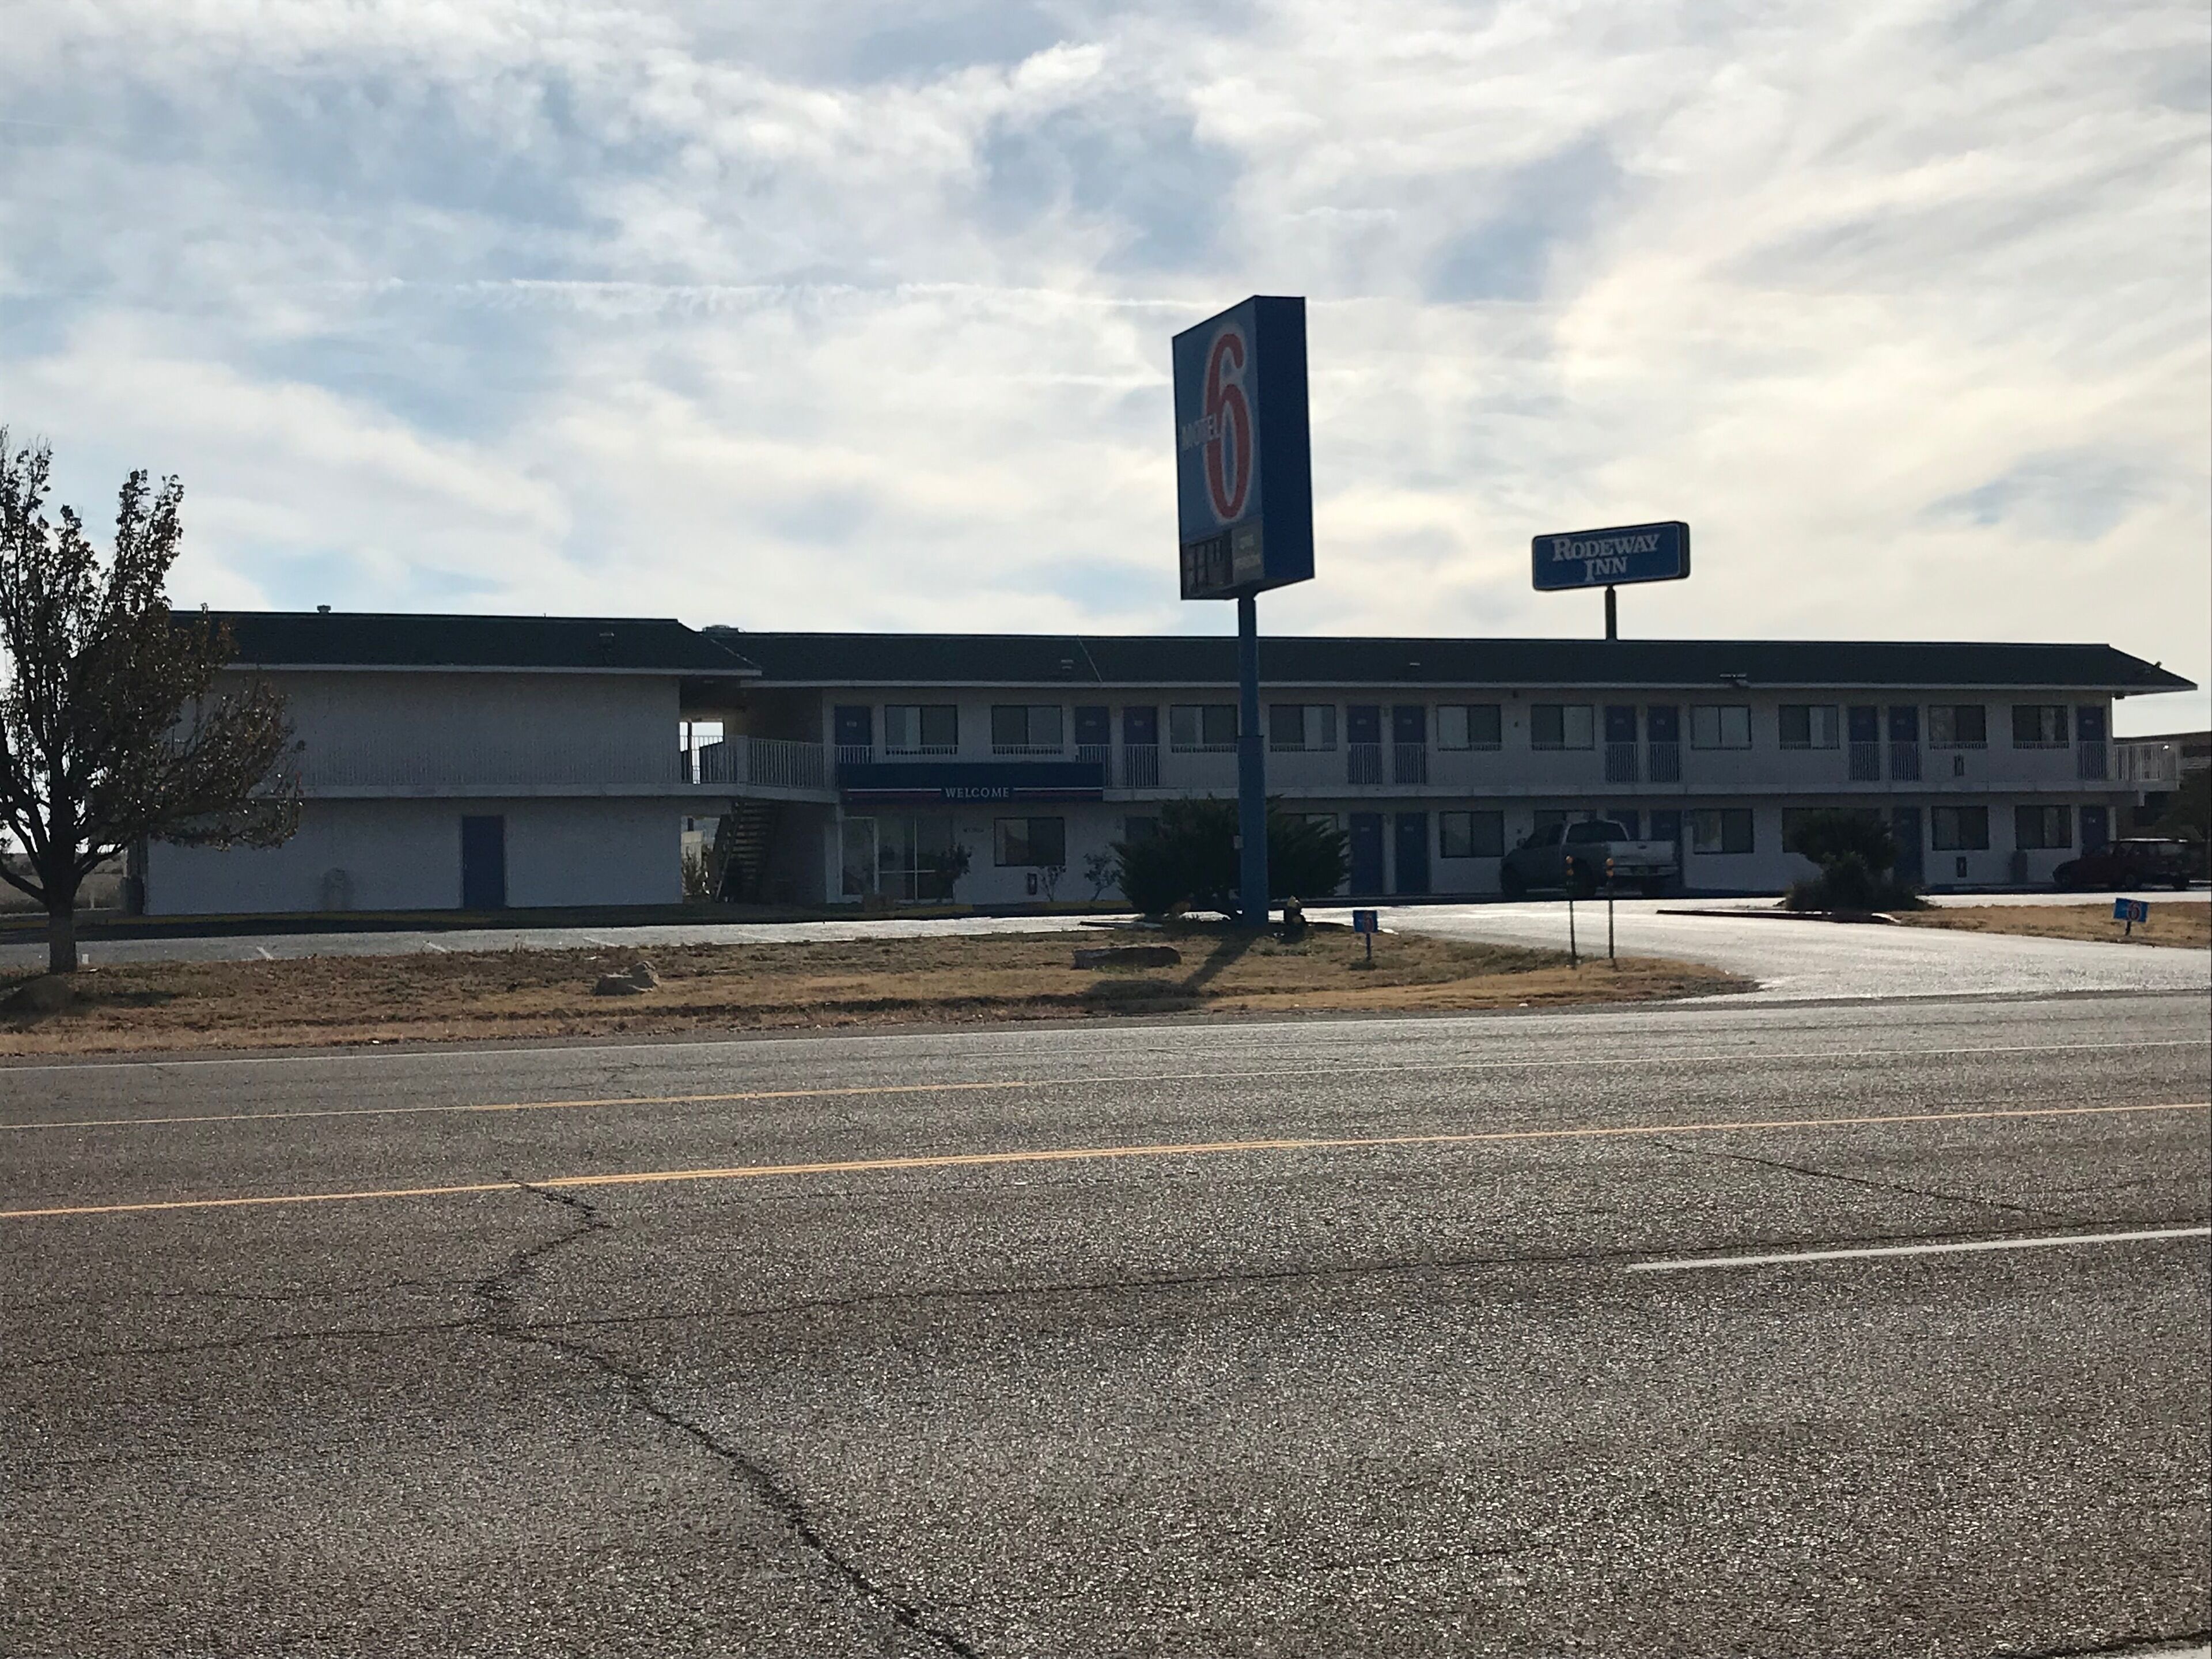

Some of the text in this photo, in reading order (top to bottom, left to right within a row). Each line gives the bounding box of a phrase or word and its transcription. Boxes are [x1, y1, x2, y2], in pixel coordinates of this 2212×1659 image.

[1181, 332, 1251, 520] MOTEL 6
[1551, 533, 1661, 562] RODEWAY
[1584, 556, 1628, 582] INN
[945, 787, 1009, 798] WELCOME
[2128, 900, 2140, 921] 6
